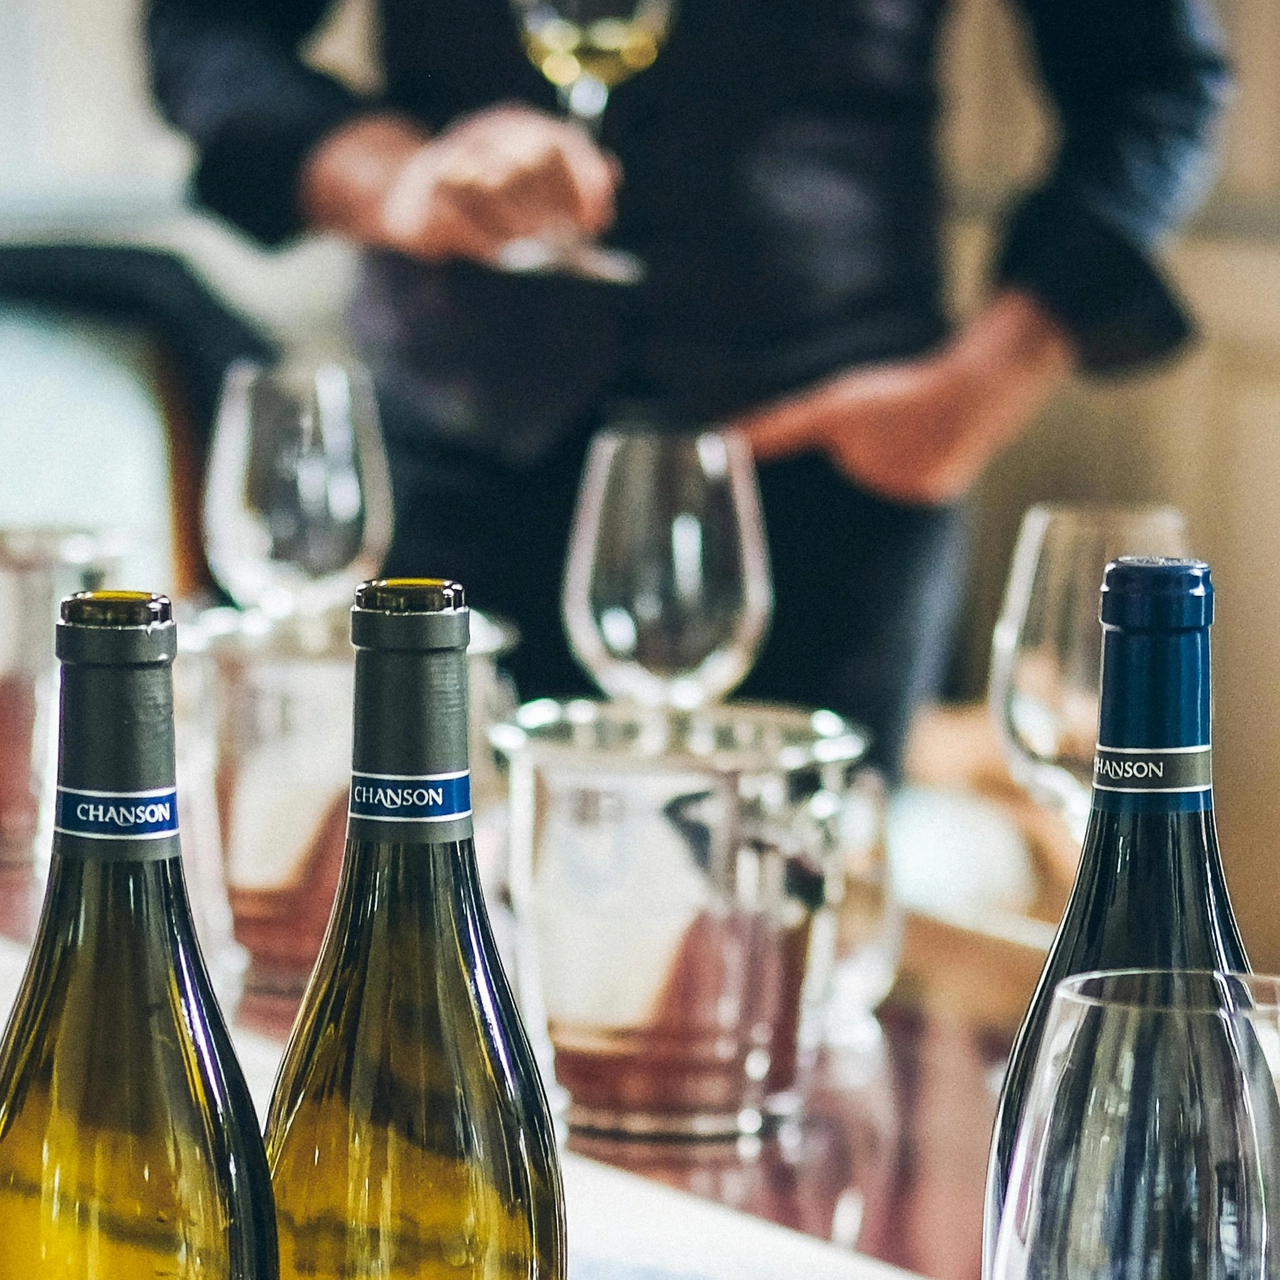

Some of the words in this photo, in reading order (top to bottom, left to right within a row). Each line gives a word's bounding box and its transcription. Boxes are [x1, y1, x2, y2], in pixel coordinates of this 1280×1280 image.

[1094, 755, 1164, 780] HANSON
[354, 785, 444, 809] CHANSON
[76, 801, 171, 827] CHANSON
